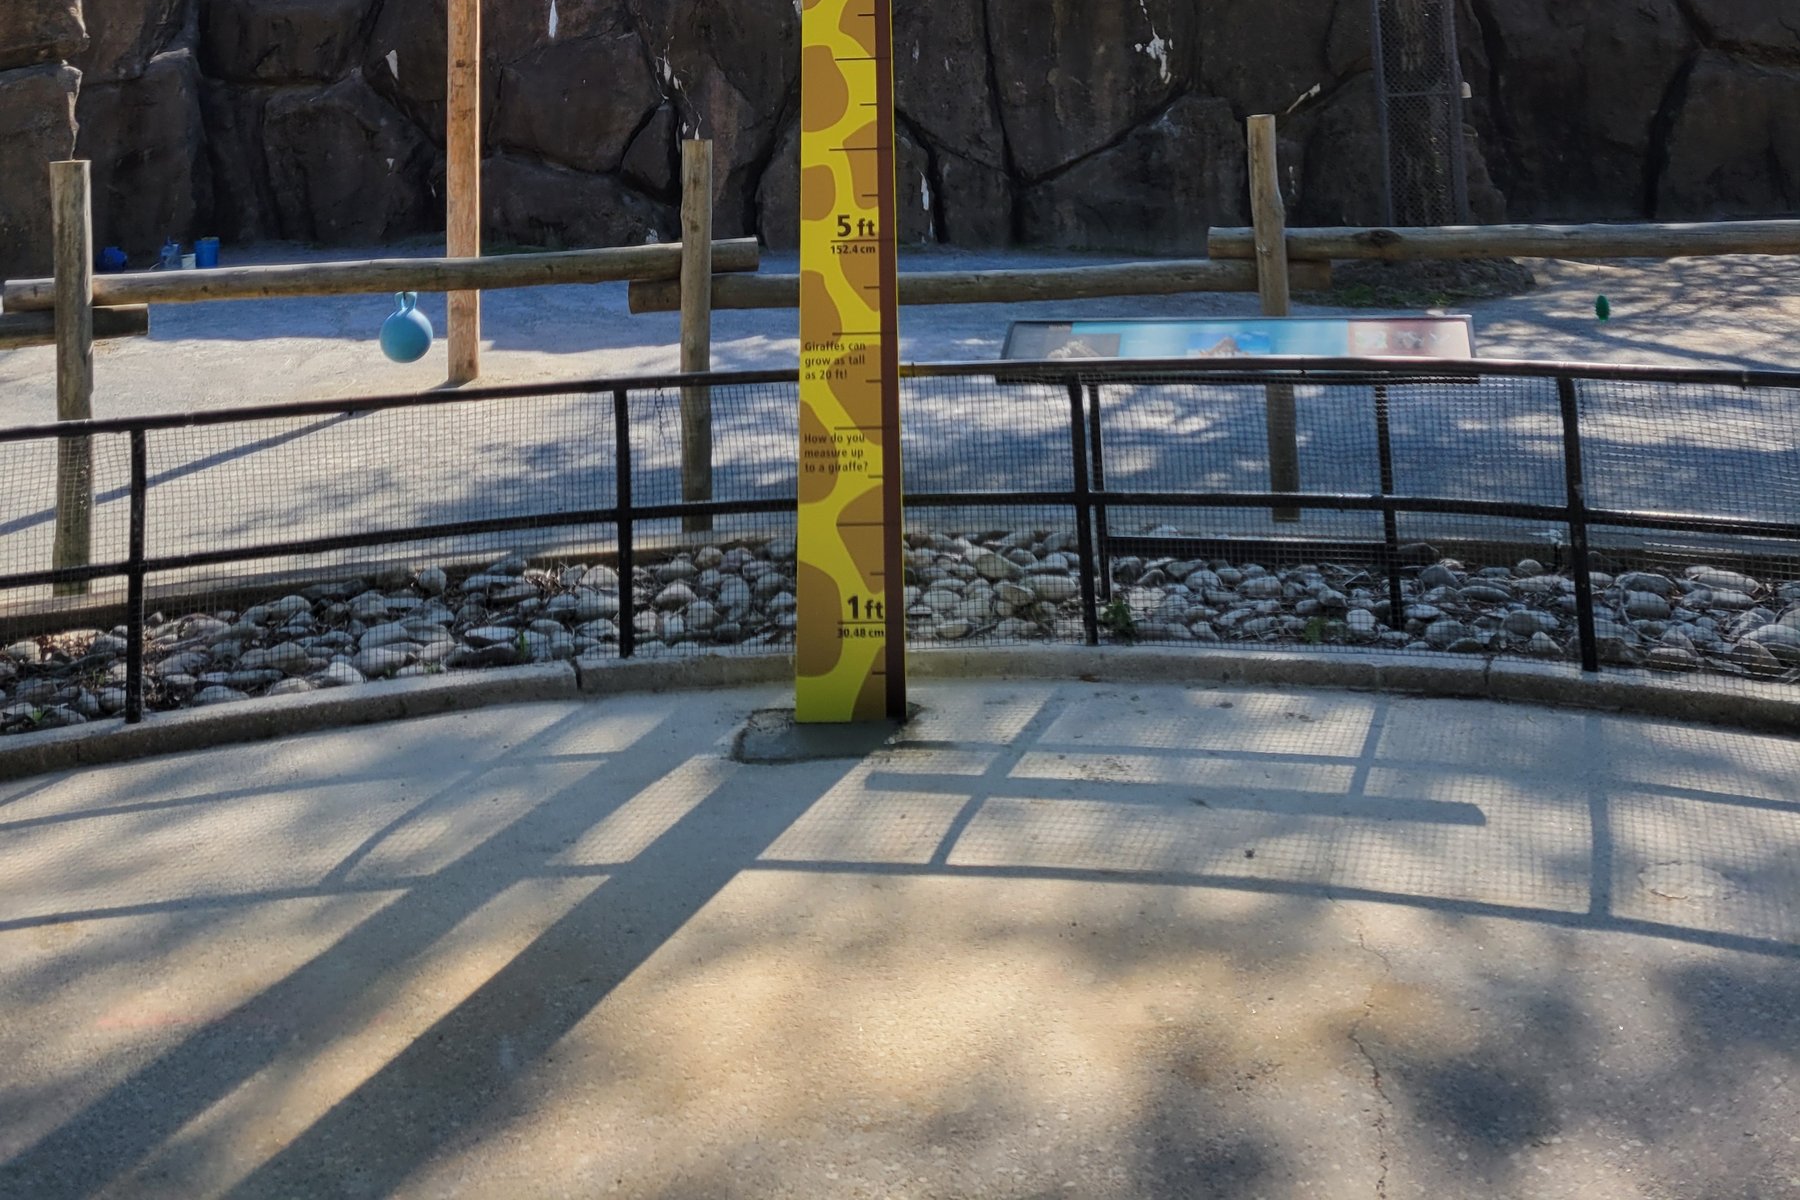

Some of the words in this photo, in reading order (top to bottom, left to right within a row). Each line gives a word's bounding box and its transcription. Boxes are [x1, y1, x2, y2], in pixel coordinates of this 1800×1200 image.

[837, 214, 852, 237] 5
[856, 217, 876, 237] ft
[830, 244, 859, 254] 152.4
[860, 245, 876, 254] cm
[804, 341, 845, 351] Giraffes
[848, 342, 866, 351] can
[804, 357, 831, 368] grow
[848, 354, 865, 366] tall
[805, 371, 816, 380] as
[819, 369, 832, 380] 20
[835, 368, 848, 380] ft!
[804, 432, 827, 443] How
[830, 432, 844, 443] do
[846, 433, 865, 446] you
[804, 449, 848, 458] measure
[851, 449, 864, 459] up
[805, 462, 816, 473] to
[819, 464, 825, 472] a
[828, 460, 869, 475] giraffe?
[847, 595, 859, 620] 1
[864, 599, 884, 620] ft
[837, 628, 866, 639] 30.48
[868, 629, 884, 638] cm
